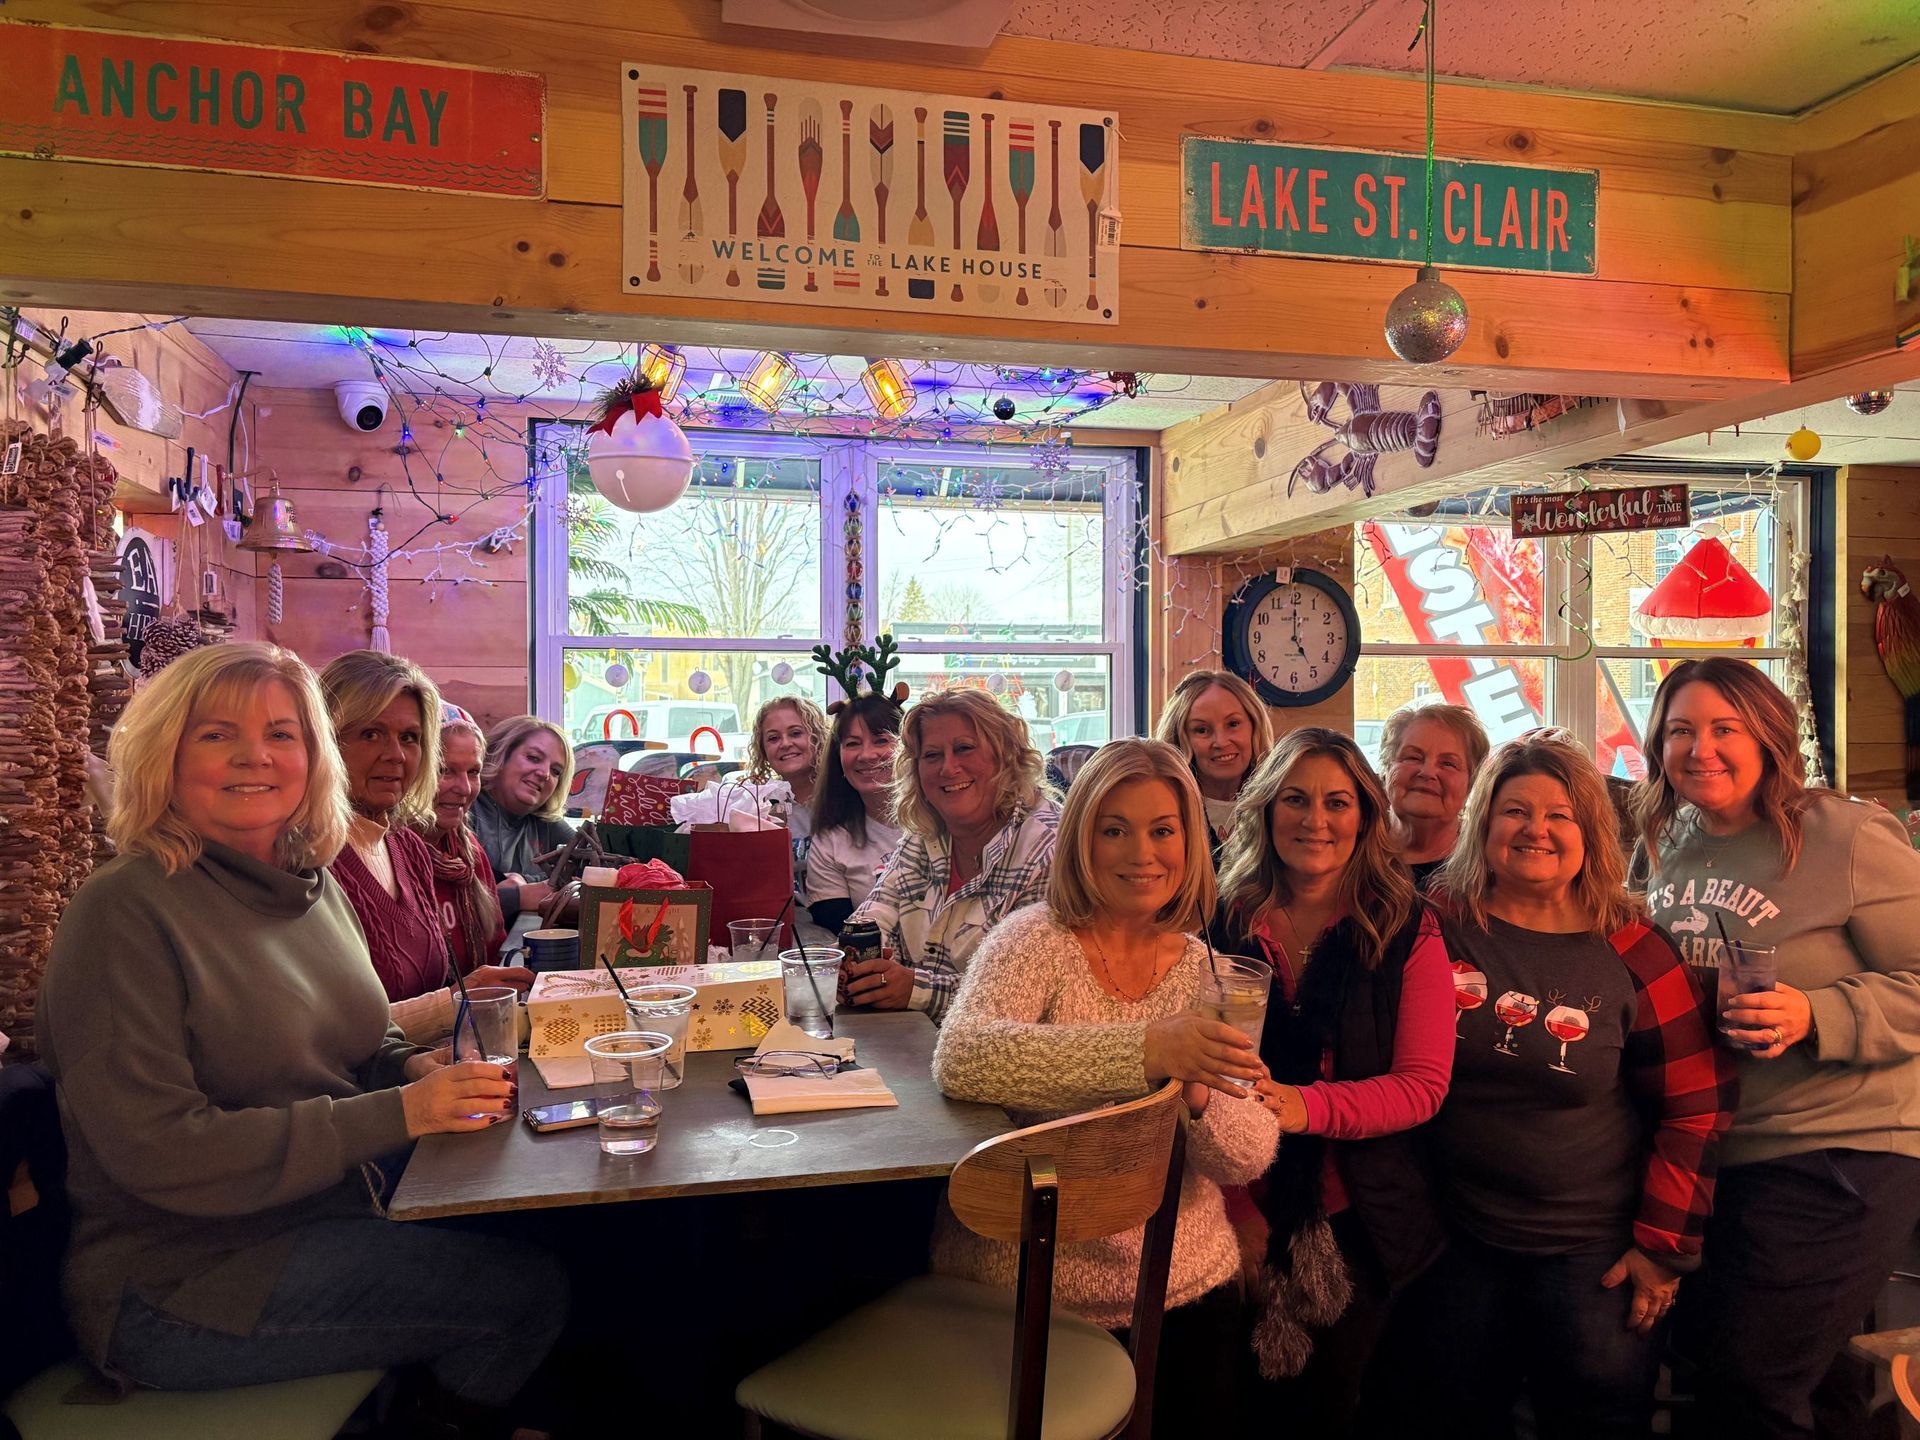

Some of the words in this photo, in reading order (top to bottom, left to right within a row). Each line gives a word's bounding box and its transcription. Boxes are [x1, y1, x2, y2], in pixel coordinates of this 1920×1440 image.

[53, 54, 306, 134] ANCHOR
[343, 81, 448, 147] BAY
[1210, 162, 1328, 233] LAKE
[1353, 173, 1418, 241] ST.
[1444, 181, 1569, 252] CLAIR
[712, 239, 856, 268] WELCOME
[891, 252, 951, 273] LAKE
[962, 258, 1042, 280] HOUSE
[1516, 496, 1530, 504] It's
[1531, 495, 1543, 503] the
[1544, 495, 1563, 503] most
[1535, 490, 1654, 531] Wonderful
[1656, 502, 1682, 513] TIME
[1642, 516, 1652, 528] of
[1652, 515, 1664, 524] the
[1664, 515, 1682, 527] year
[1271, 597, 1282, 610] 11
[1290, 591, 1301, 605] 12
[1311, 599, 1317, 610] 1
[1257, 612, 1269, 625] 10
[1323, 612, 1331, 625] 2
[1254, 631, 1261, 644] 9
[1327, 632, 1335, 645] 3
[1258, 650, 1266, 663] 8
[1322, 650, 1329, 663] 4
[1272, 666, 1279, 679] 7
[1291, 672, 1298, 684] 6
[1309, 666, 1318, 678] 5
[1647, 882, 1675, 916] T'S
[1679, 879, 1695, 905] A
[1699, 878, 1781, 928] BEAUT
